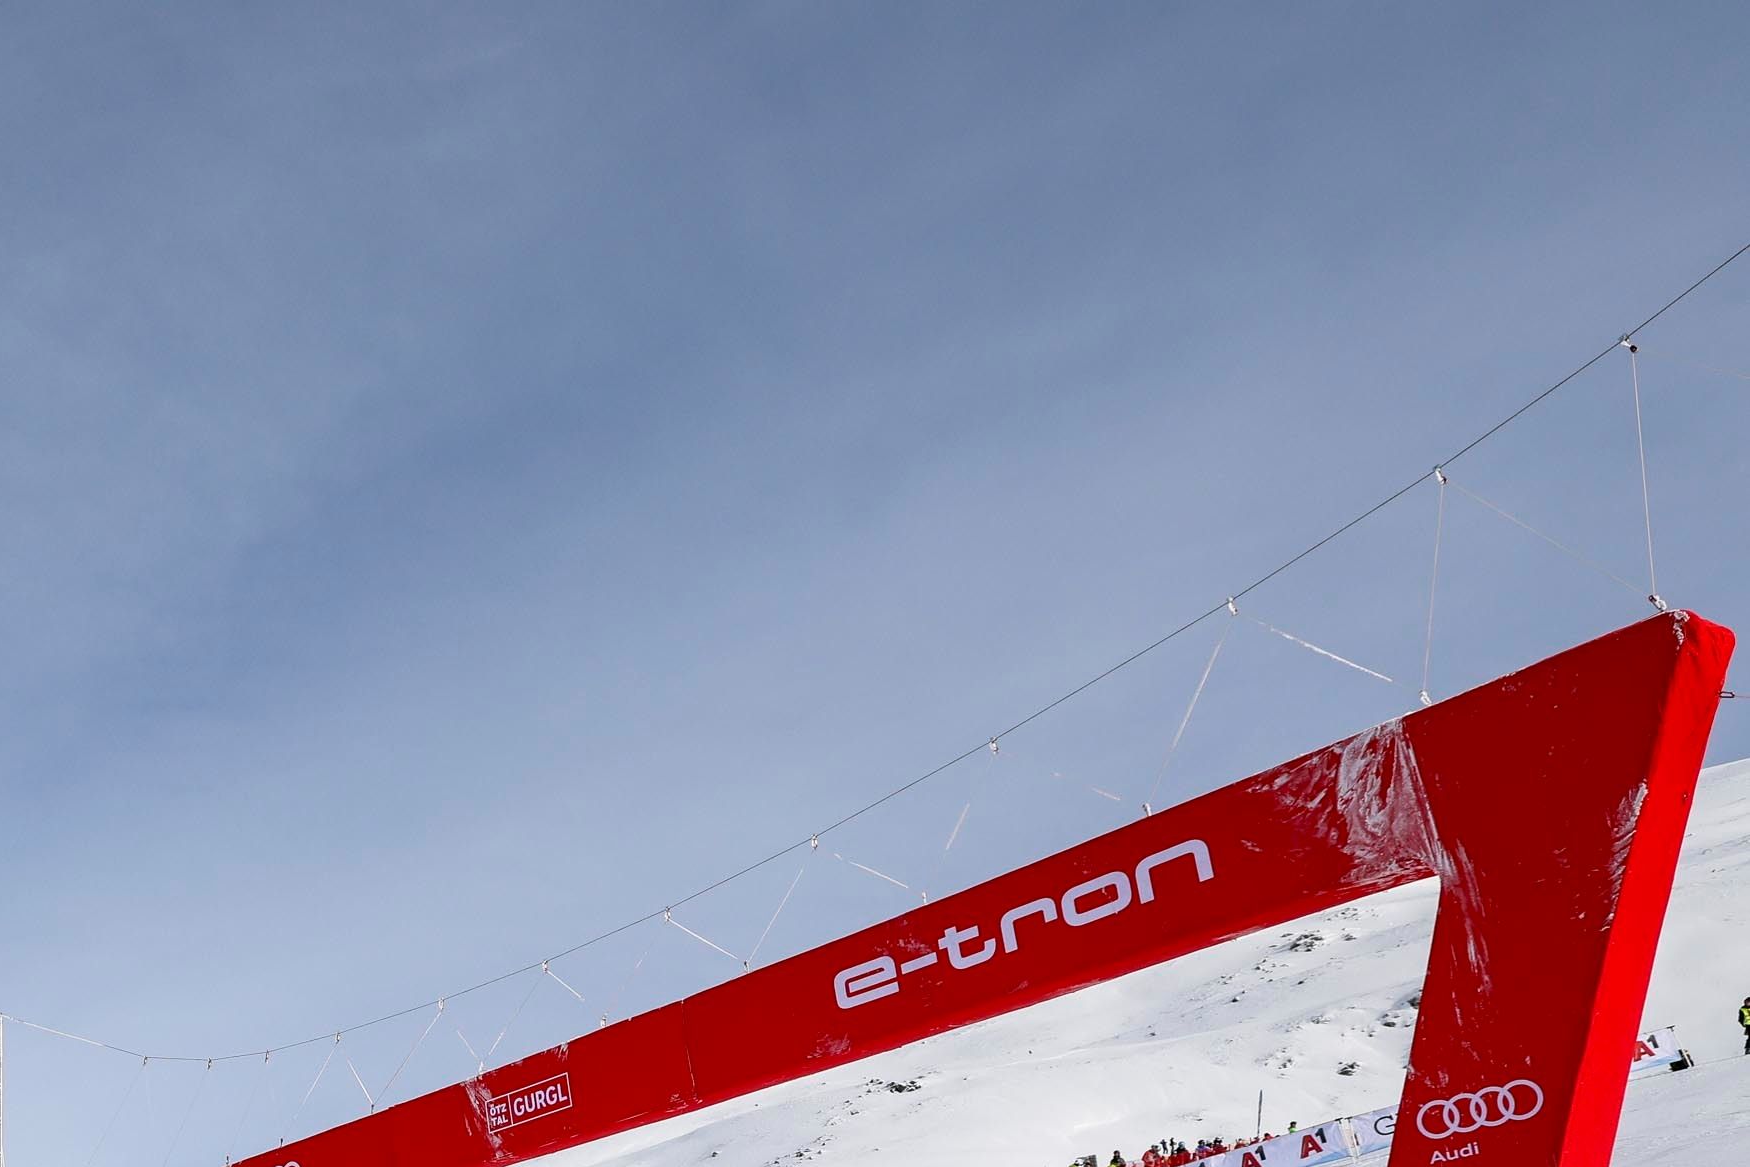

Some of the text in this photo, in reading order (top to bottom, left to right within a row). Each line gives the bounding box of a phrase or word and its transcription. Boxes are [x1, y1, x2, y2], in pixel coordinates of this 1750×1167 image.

[834, 839, 1214, 1010] e-tron
[513, 1083, 568, 1116] GURGL
[491, 1114, 508, 1126] TAL
[1300, 1127, 1327, 1159] A1
[1430, 1142, 1480, 1164] Audi
